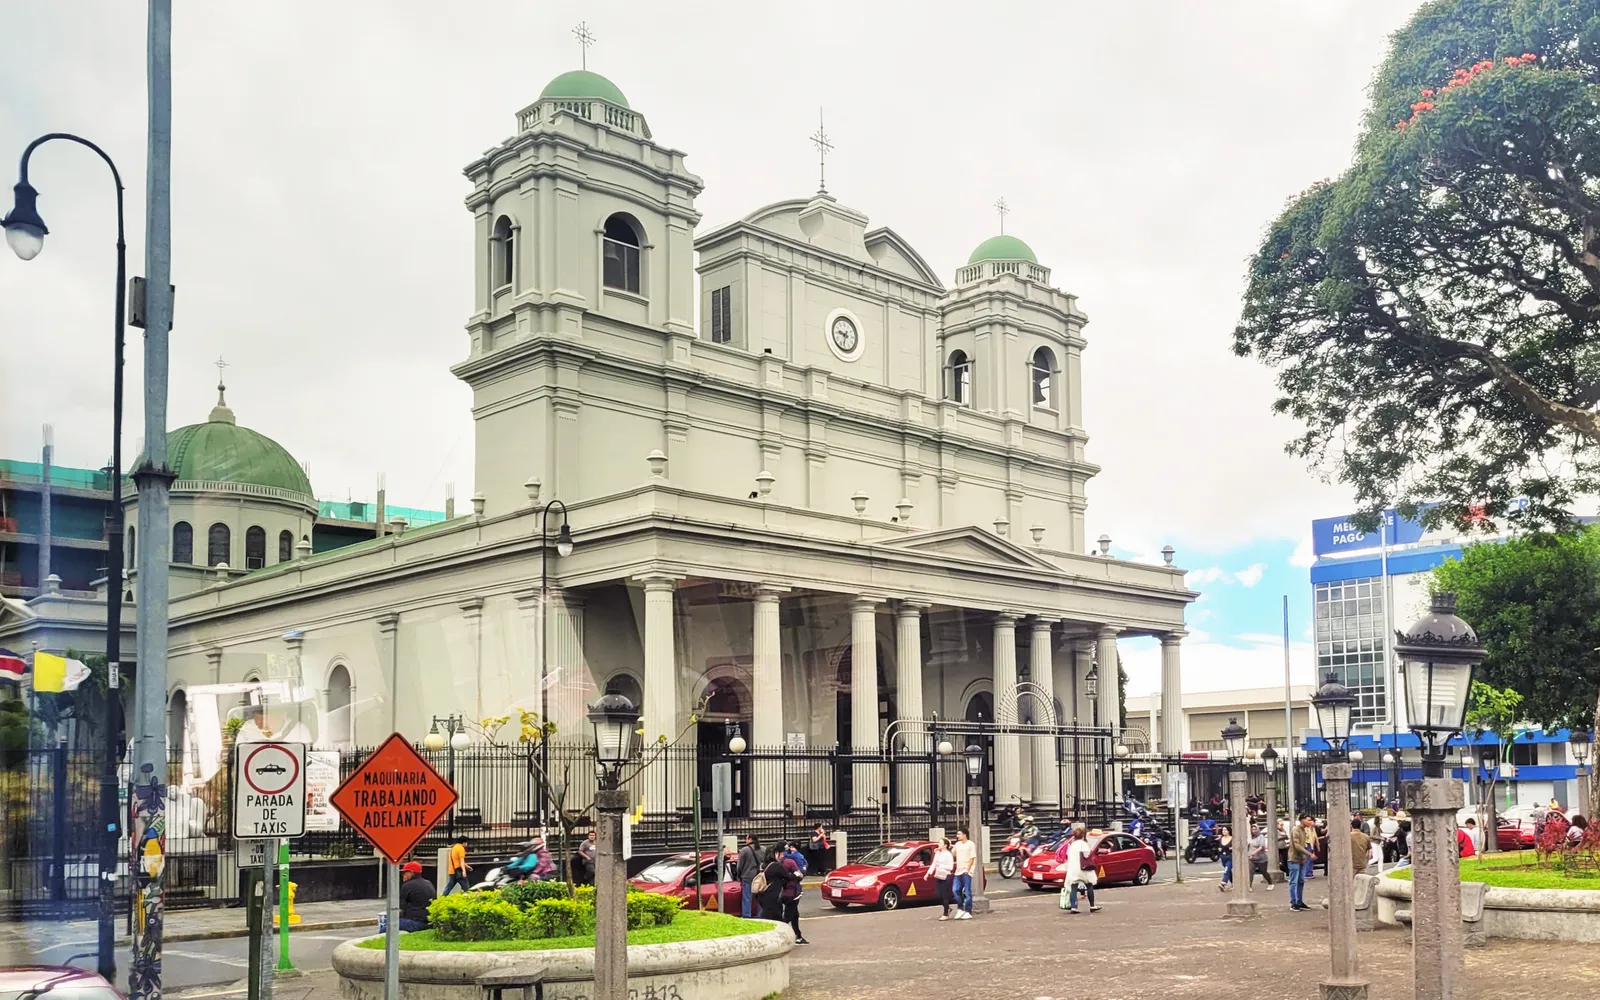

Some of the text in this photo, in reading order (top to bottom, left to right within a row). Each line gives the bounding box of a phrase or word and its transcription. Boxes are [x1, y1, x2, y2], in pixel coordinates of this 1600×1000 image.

[1333, 532, 1365, 545] PAGO
[364, 771, 427, 785] MAQUINARIA
[246, 794, 294, 807] PARADA
[353, 788, 437, 807] TRABAJANDO
[262, 808, 277, 820] DE
[363, 810, 427, 829] ADELANTE
[253, 821, 287, 834] TAXIS
